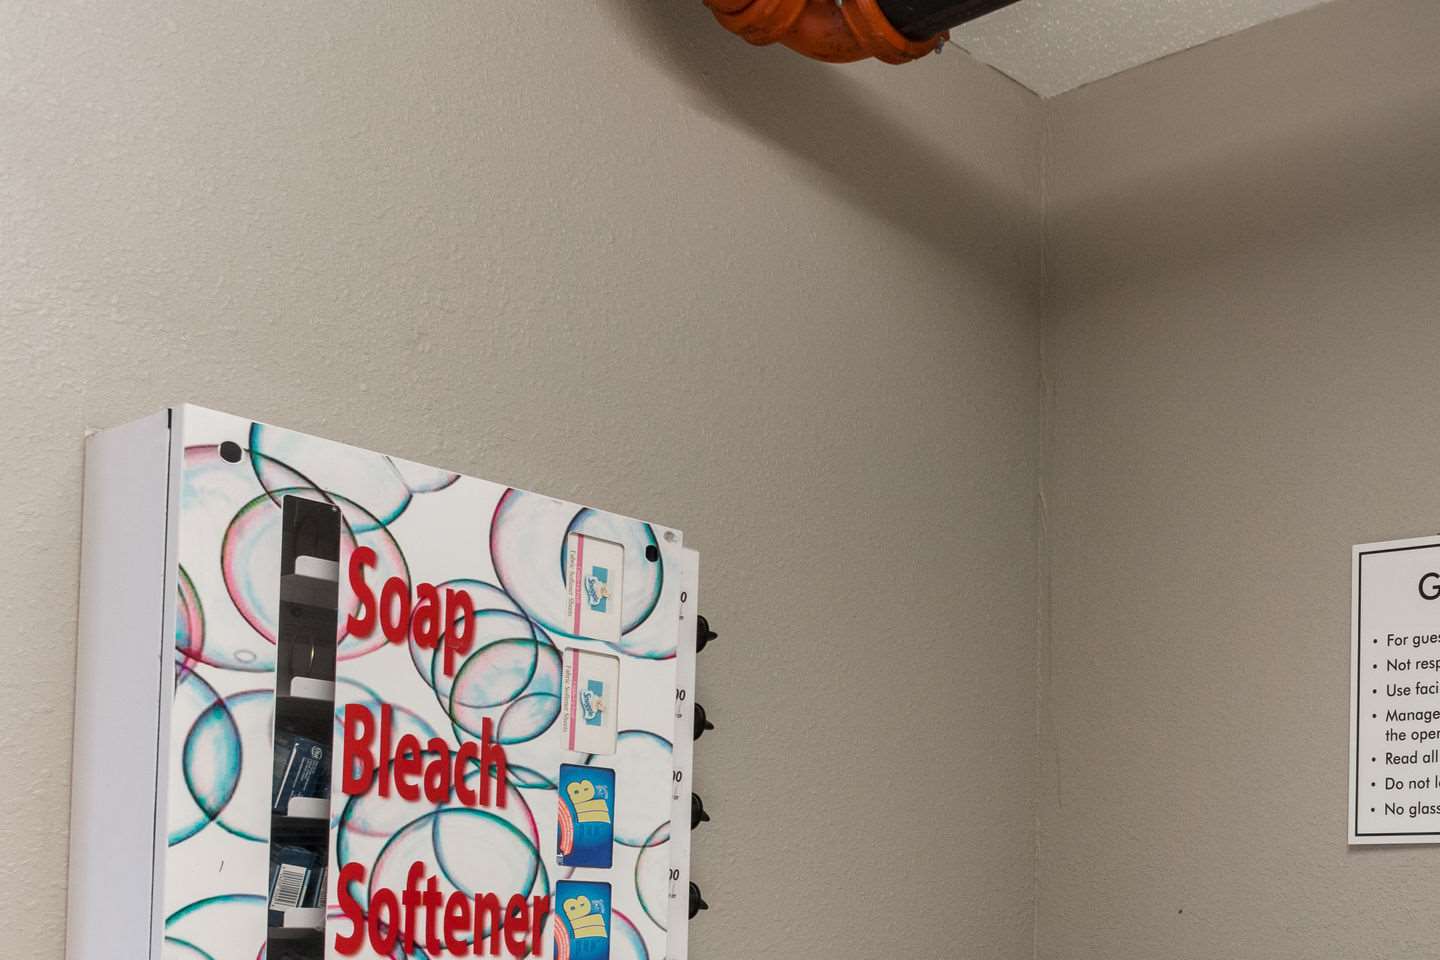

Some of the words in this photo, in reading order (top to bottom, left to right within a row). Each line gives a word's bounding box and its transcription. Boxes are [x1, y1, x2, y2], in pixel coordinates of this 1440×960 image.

[347, 545, 475, 676] Soap
[1388, 634, 1408, 646] For
[1387, 659, 1411, 671] Not
[1387, 684, 1411, 696] Use
[583, 690, 594, 719] Snuggle
[1385, 728, 1406, 741] the
[342, 703, 507, 808] Bleach
[1386, 750, 1417, 764] Read
[1423, 750, 1438, 763] all
[1386, 777, 1404, 790] Do
[1409, 777, 1430, 789] not
[1385, 803, 1404, 815] No
[335, 860, 550, 957] Softener
